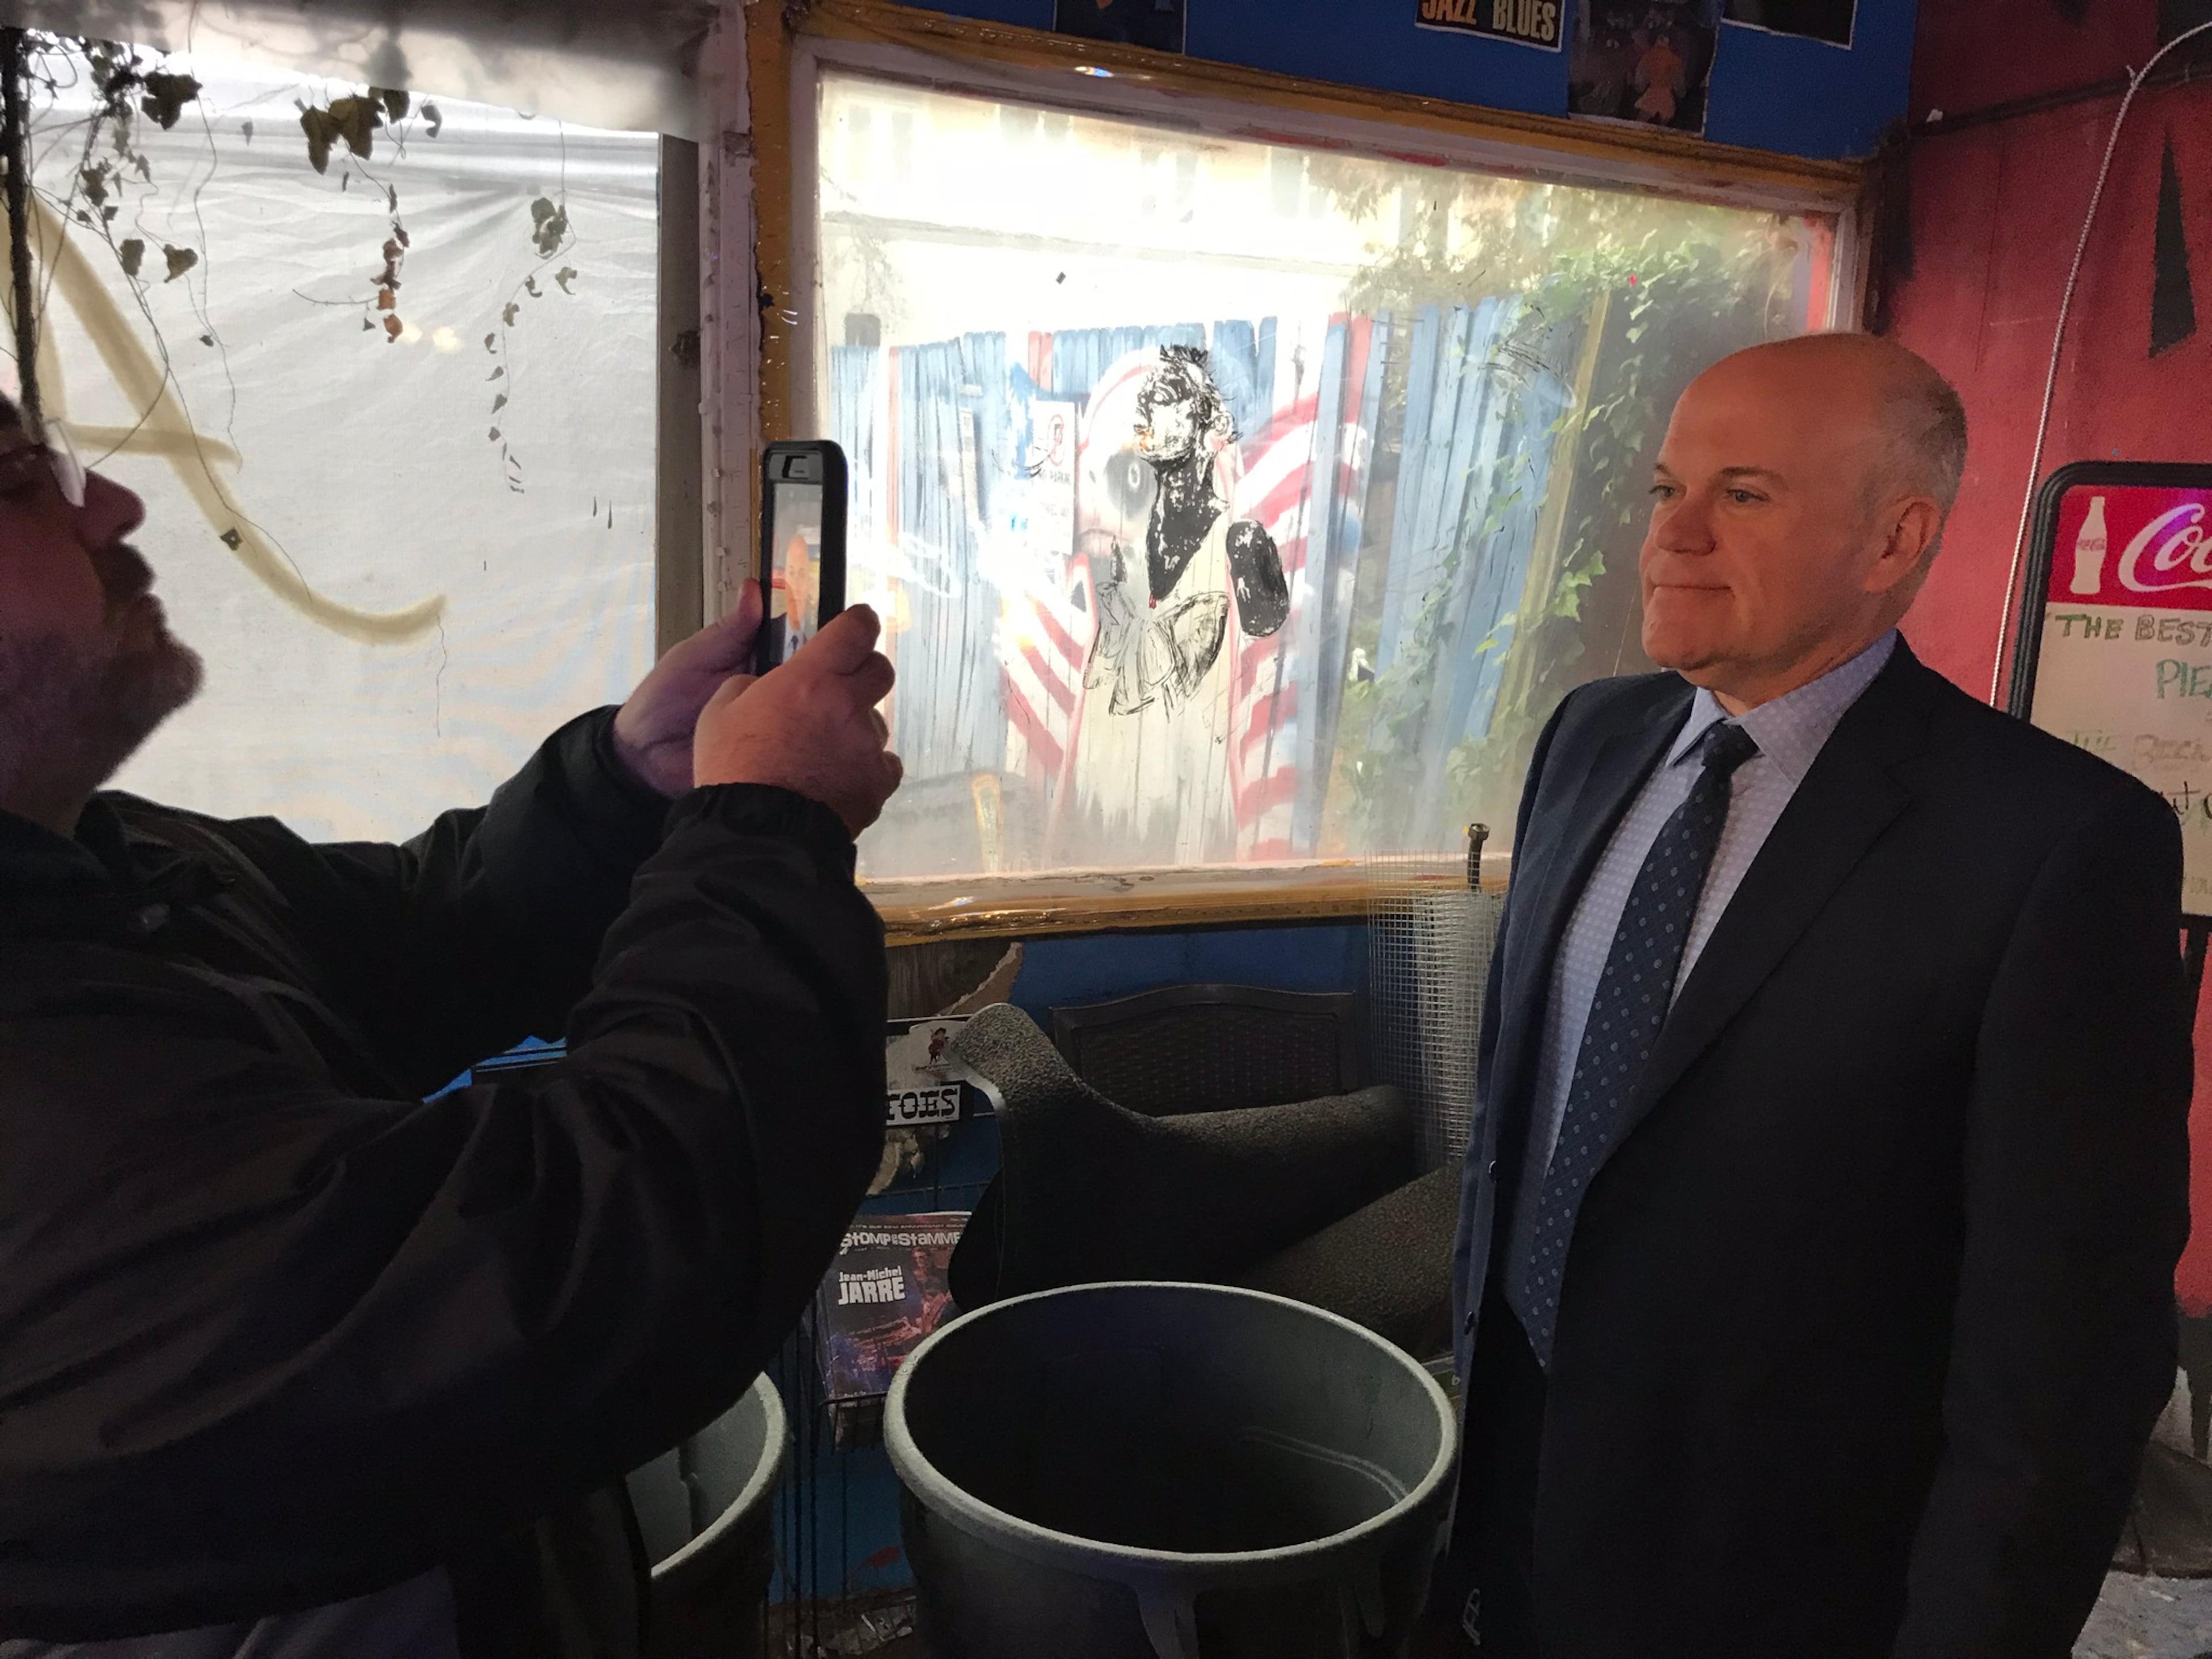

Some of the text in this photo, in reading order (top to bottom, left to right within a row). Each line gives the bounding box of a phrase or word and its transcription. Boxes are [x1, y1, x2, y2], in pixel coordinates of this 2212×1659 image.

[1421, 0, 1555, 41] JAZZ BLUES
[2055, 613, 2212, 647] THE BEST
[839, 1265, 902, 1282] Jean-Michel
[838, 1276, 906, 1305] JARRE
